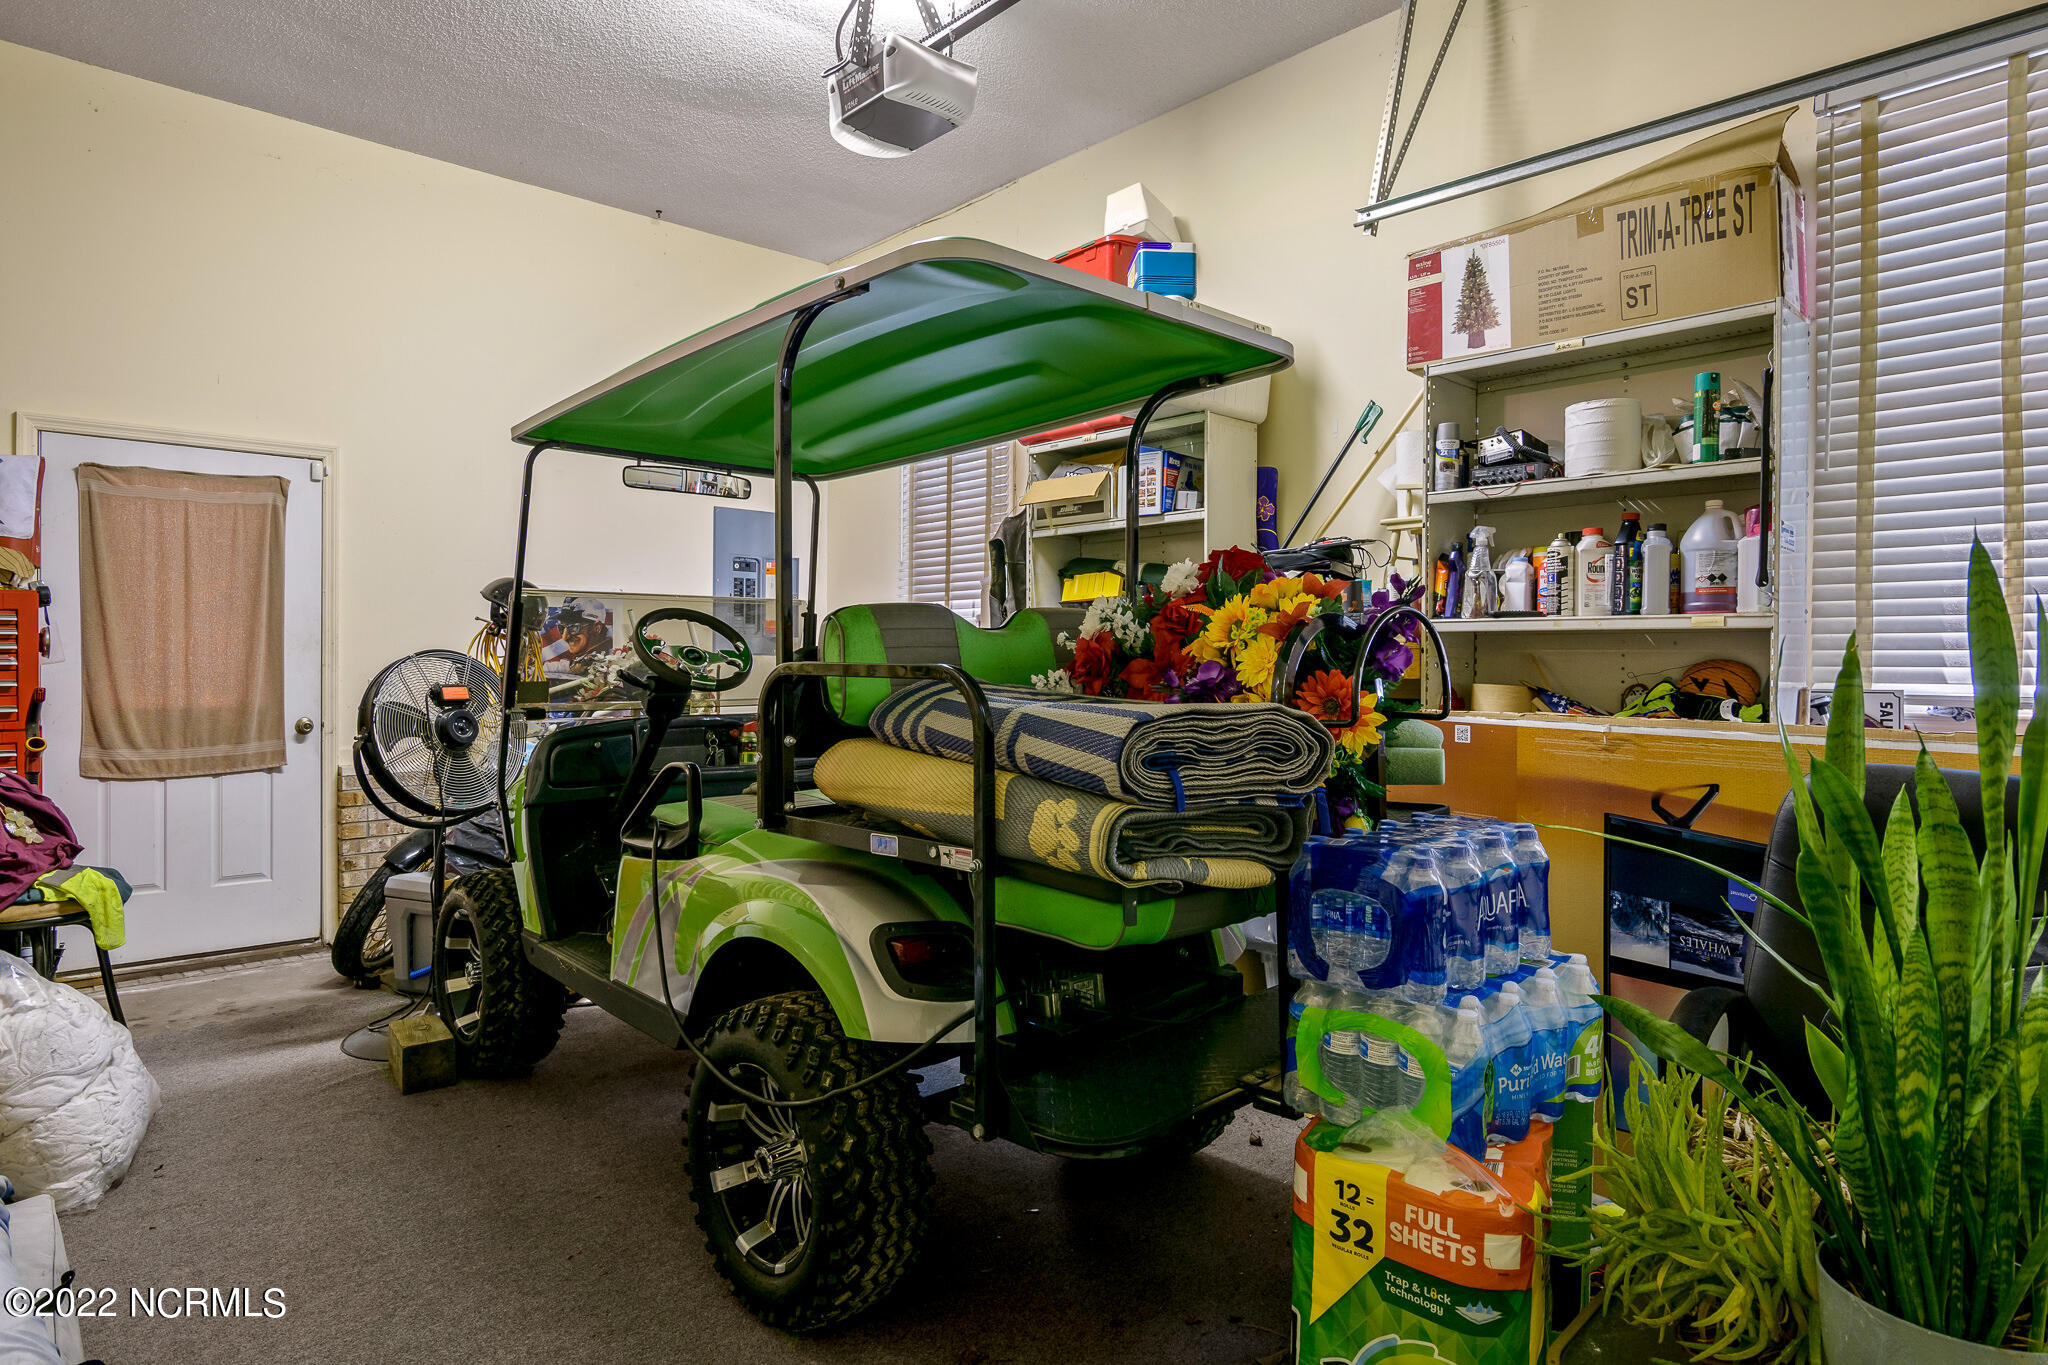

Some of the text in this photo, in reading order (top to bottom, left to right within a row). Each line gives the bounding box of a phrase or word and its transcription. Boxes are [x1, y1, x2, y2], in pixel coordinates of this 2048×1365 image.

[842, 63, 880, 91] LiftMaster
[1616, 182, 1756, 261] TRIM-A-TREE ST
[1623, 269, 1654, 281] TRIM-A-TREE
[1625, 283, 1652, 309] ST
[1587, 561, 1605, 574] Roun
[1679, 935, 1731, 956] WHALES
[1334, 1179, 1360, 1207] 12
[1340, 1201, 1356, 1211] ROLLS
[1329, 1208, 1373, 1254] 32
[1405, 1203, 1461, 1240] FULL
[1331, 1243, 1369, 1261] REGULAR ROLLS
[1389, 1221, 1477, 1267] SHEETS
[1384, 1270, 1451, 1305] Trap & Lock
[1384, 1282, 1444, 1316] Technology
